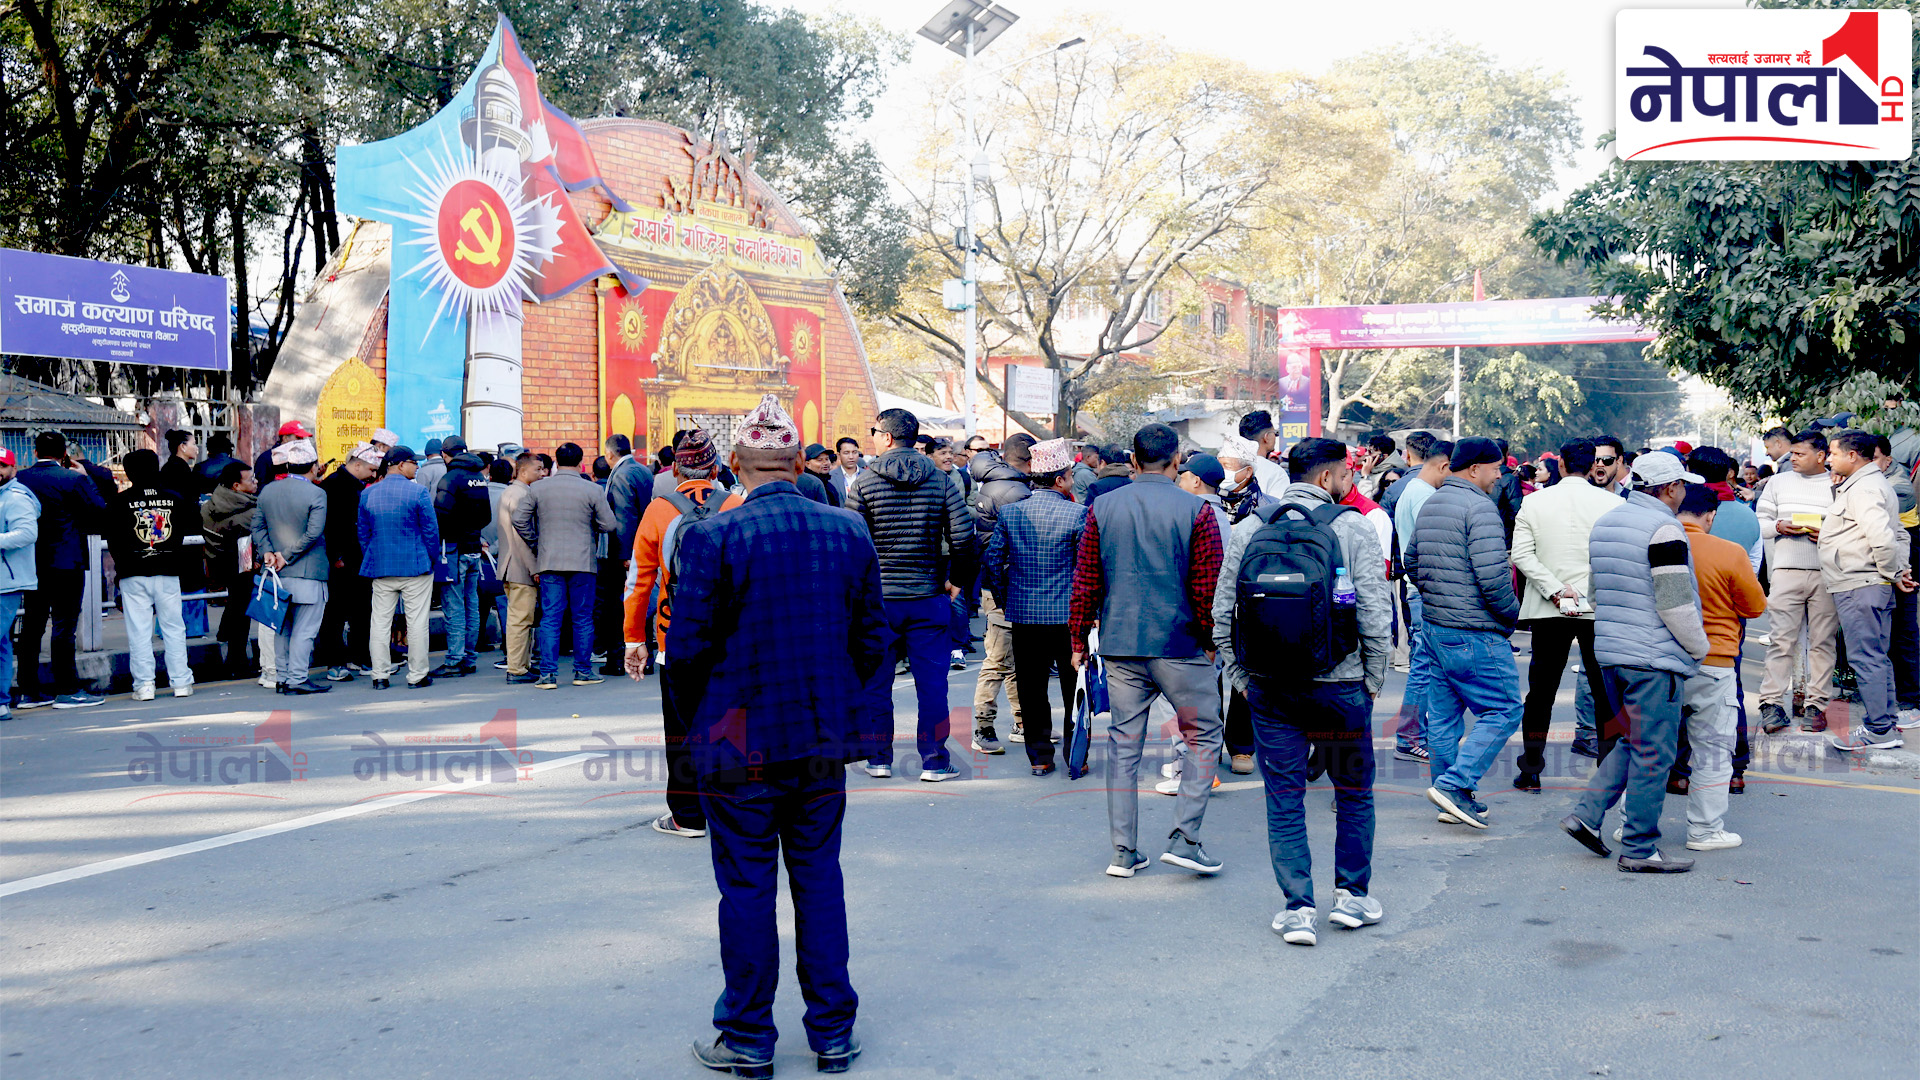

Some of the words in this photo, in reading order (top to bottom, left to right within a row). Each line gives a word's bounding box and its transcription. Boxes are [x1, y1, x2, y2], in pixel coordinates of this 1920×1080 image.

[699, 206, 720, 219] नेकपा
[15, 294, 76, 319] समाज
[82, 301, 155, 326] कल्याण
[155, 330, 179, 342] विभाग
[129, 500, 147, 509] LEO
[149, 499, 174, 507] MESSI
